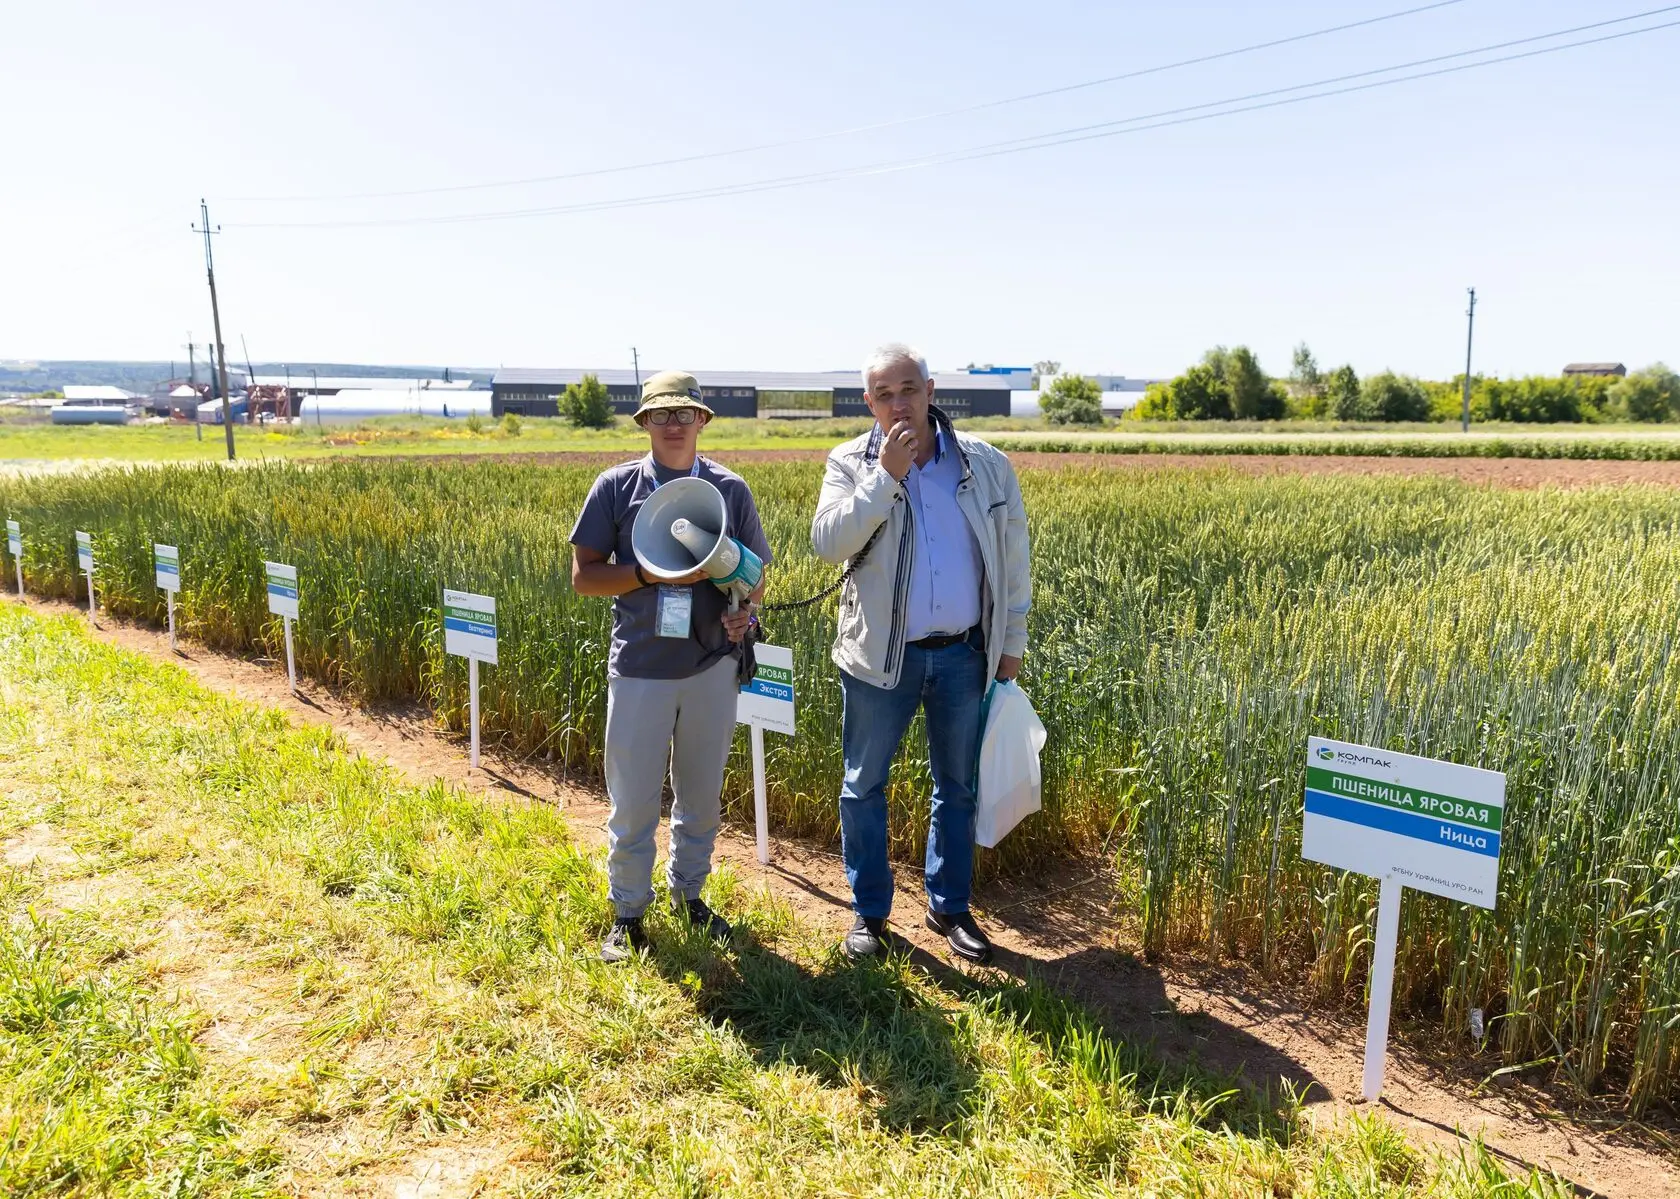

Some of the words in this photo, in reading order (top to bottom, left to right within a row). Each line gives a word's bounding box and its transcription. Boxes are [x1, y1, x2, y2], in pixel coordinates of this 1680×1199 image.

[474, 613, 493, 623] ЯРОВАЯ
[758, 667, 787, 680] ЯРОВАЯ
[759, 683, 788, 697] Экстра
[1338, 751, 1391, 768] КОМПАК
[1332, 776, 1413, 806] ПШЕНИЦА
[1419, 796, 1489, 823] ЯРОВАЯ
[1440, 825, 1487, 849] Ница
[1392, 866, 1414, 877] ФГБНУ
[1452, 882, 1467, 891] УРО
[1468, 886, 1483, 895] РАН
